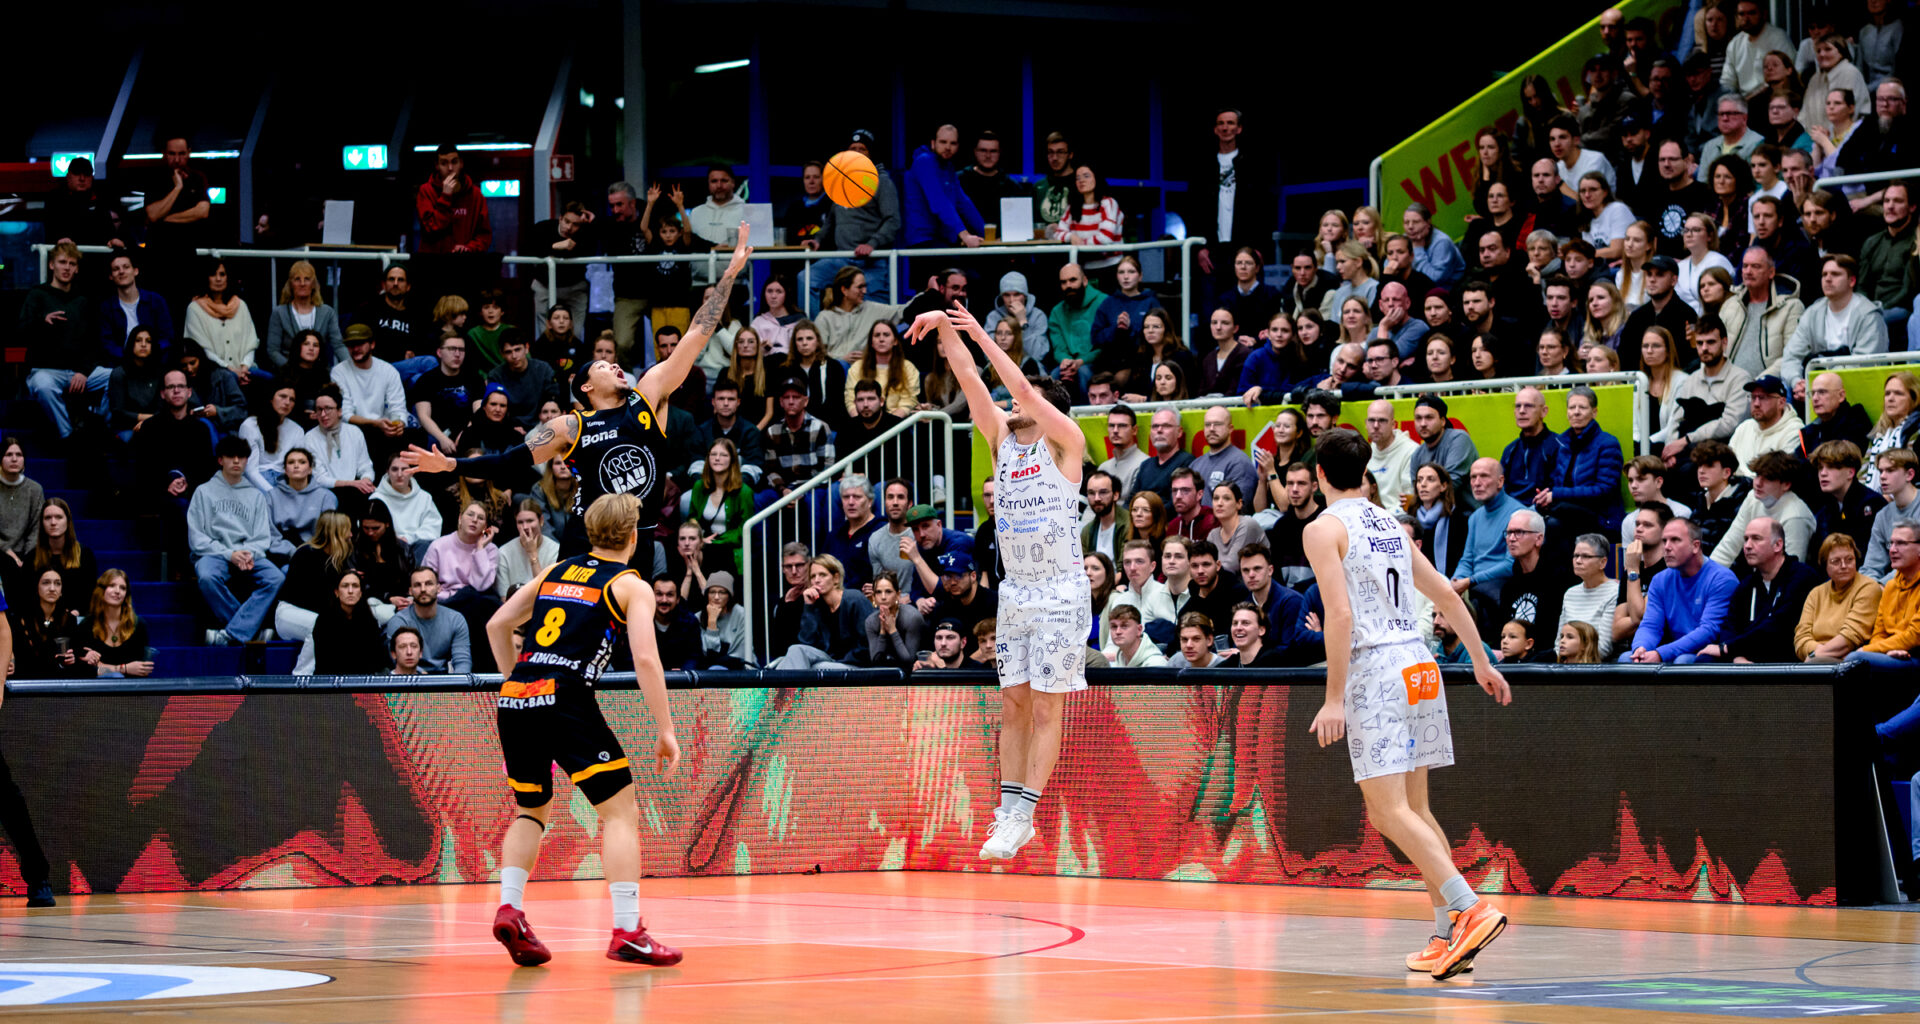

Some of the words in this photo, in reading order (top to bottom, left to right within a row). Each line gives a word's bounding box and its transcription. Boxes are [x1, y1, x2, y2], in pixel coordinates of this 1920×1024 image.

[637, 411, 652, 430] 9
[581, 429, 619, 448] Bona
[602, 449, 642, 479] KREIS
[1011, 464, 1041, 479] RATIO
[611, 465, 648, 495] BAU
[1011, 515, 1048, 526] Stadtwerke
[1013, 525, 1040, 534] Münster
[552, 585, 585, 598] AREIS
[535, 607, 566, 647] 8
